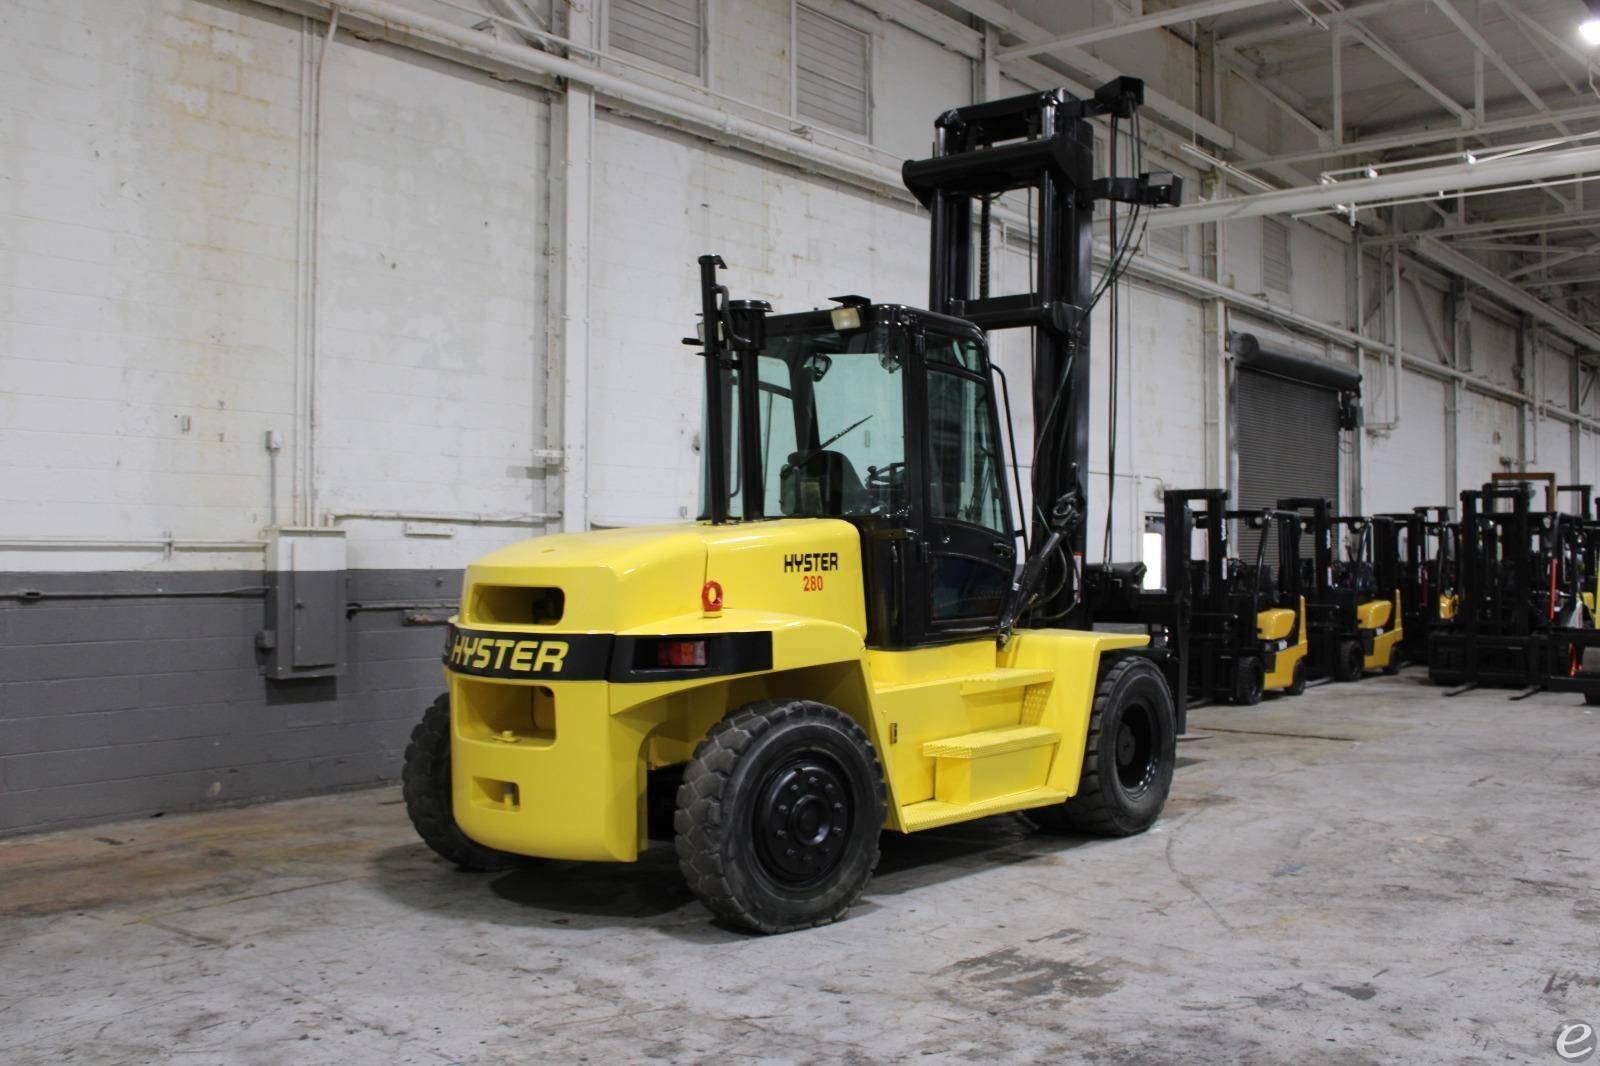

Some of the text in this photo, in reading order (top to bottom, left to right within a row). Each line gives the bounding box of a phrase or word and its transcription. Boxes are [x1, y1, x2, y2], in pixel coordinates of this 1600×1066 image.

[784, 552, 838, 573] HYSTER
[803, 575, 823, 592] 280
[450, 634, 569, 672] HYSTER
